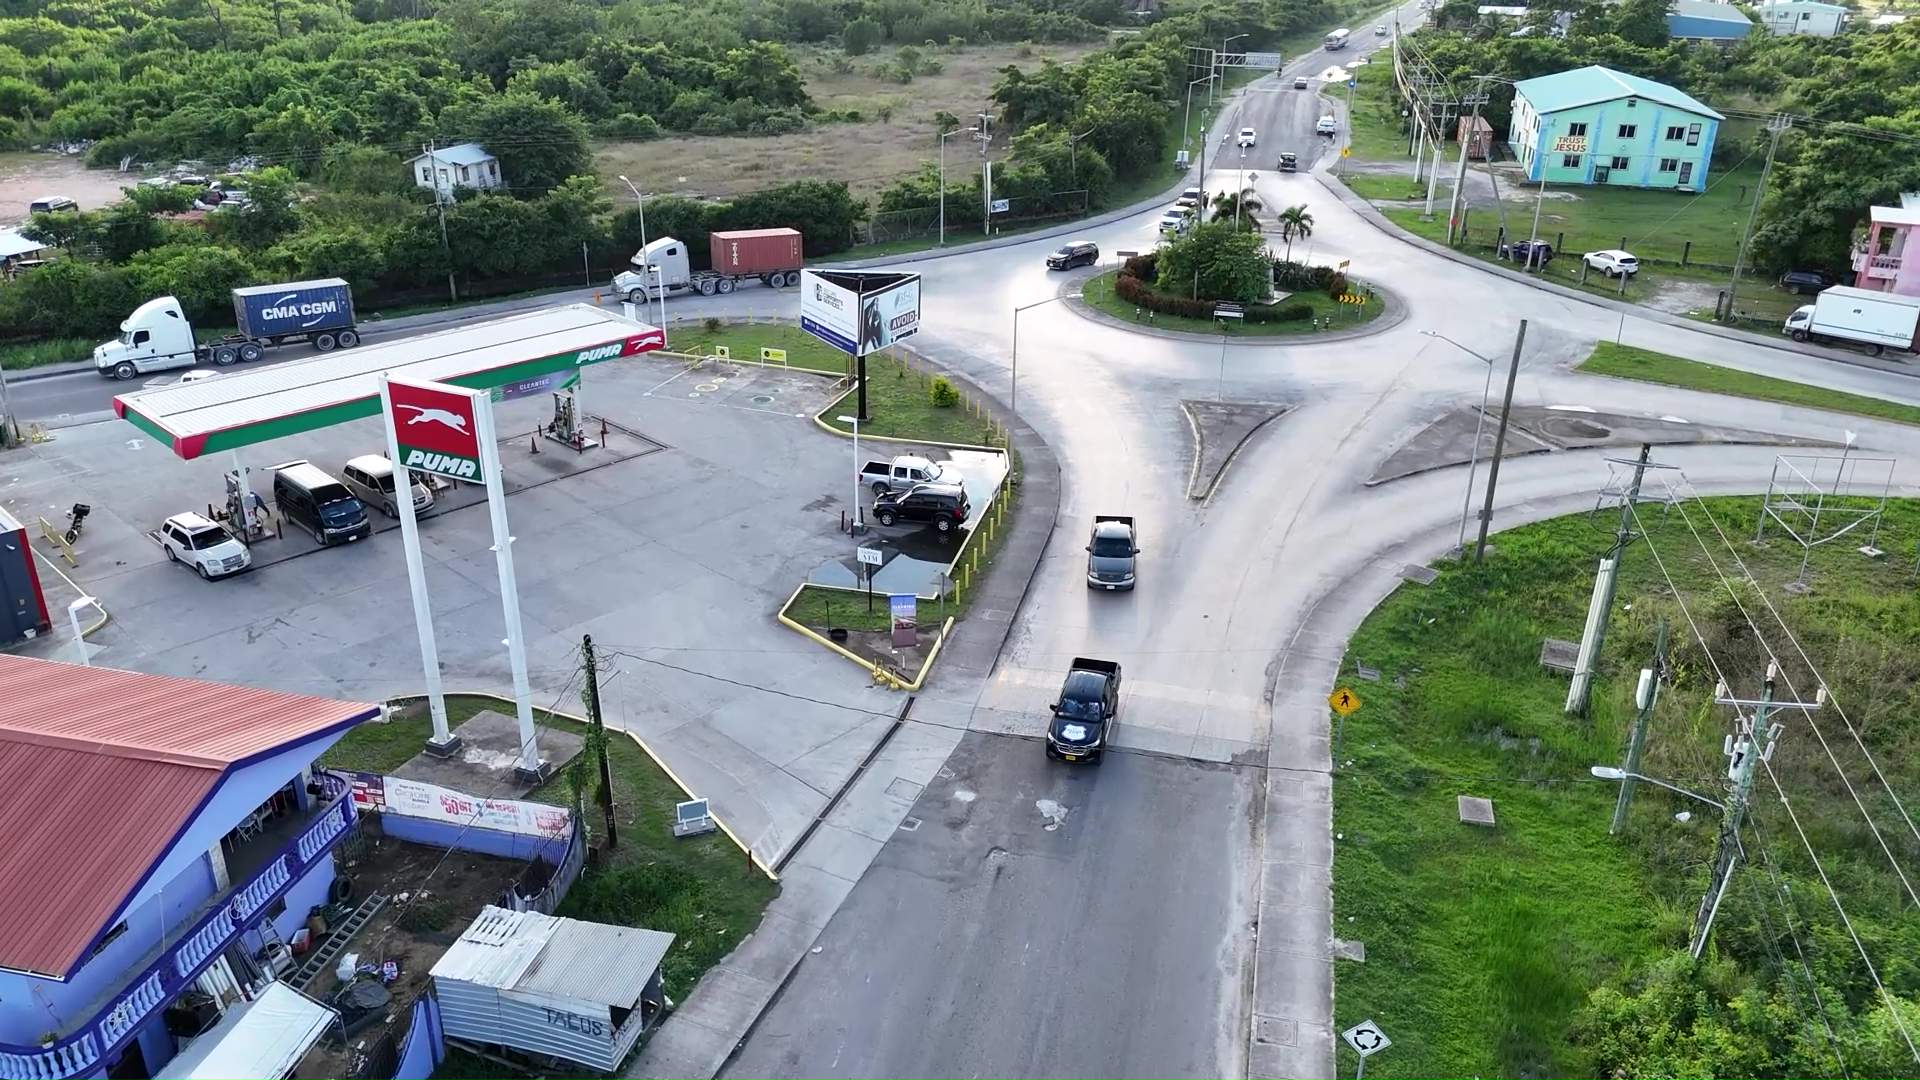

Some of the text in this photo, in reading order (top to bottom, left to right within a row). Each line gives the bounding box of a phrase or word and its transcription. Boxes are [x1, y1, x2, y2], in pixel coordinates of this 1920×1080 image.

[1553, 143, 1587, 152] JESUS
[1558, 136, 1586, 144] TRUST
[262, 301, 336, 320] CMA CGM
[892, 311, 915, 329] AVOID
[575, 343, 622, 364] PUMA
[405, 449, 476, 477] PUMA
[863, 553, 878, 563] ATM
[541, 1007, 603, 1036] TACOS
